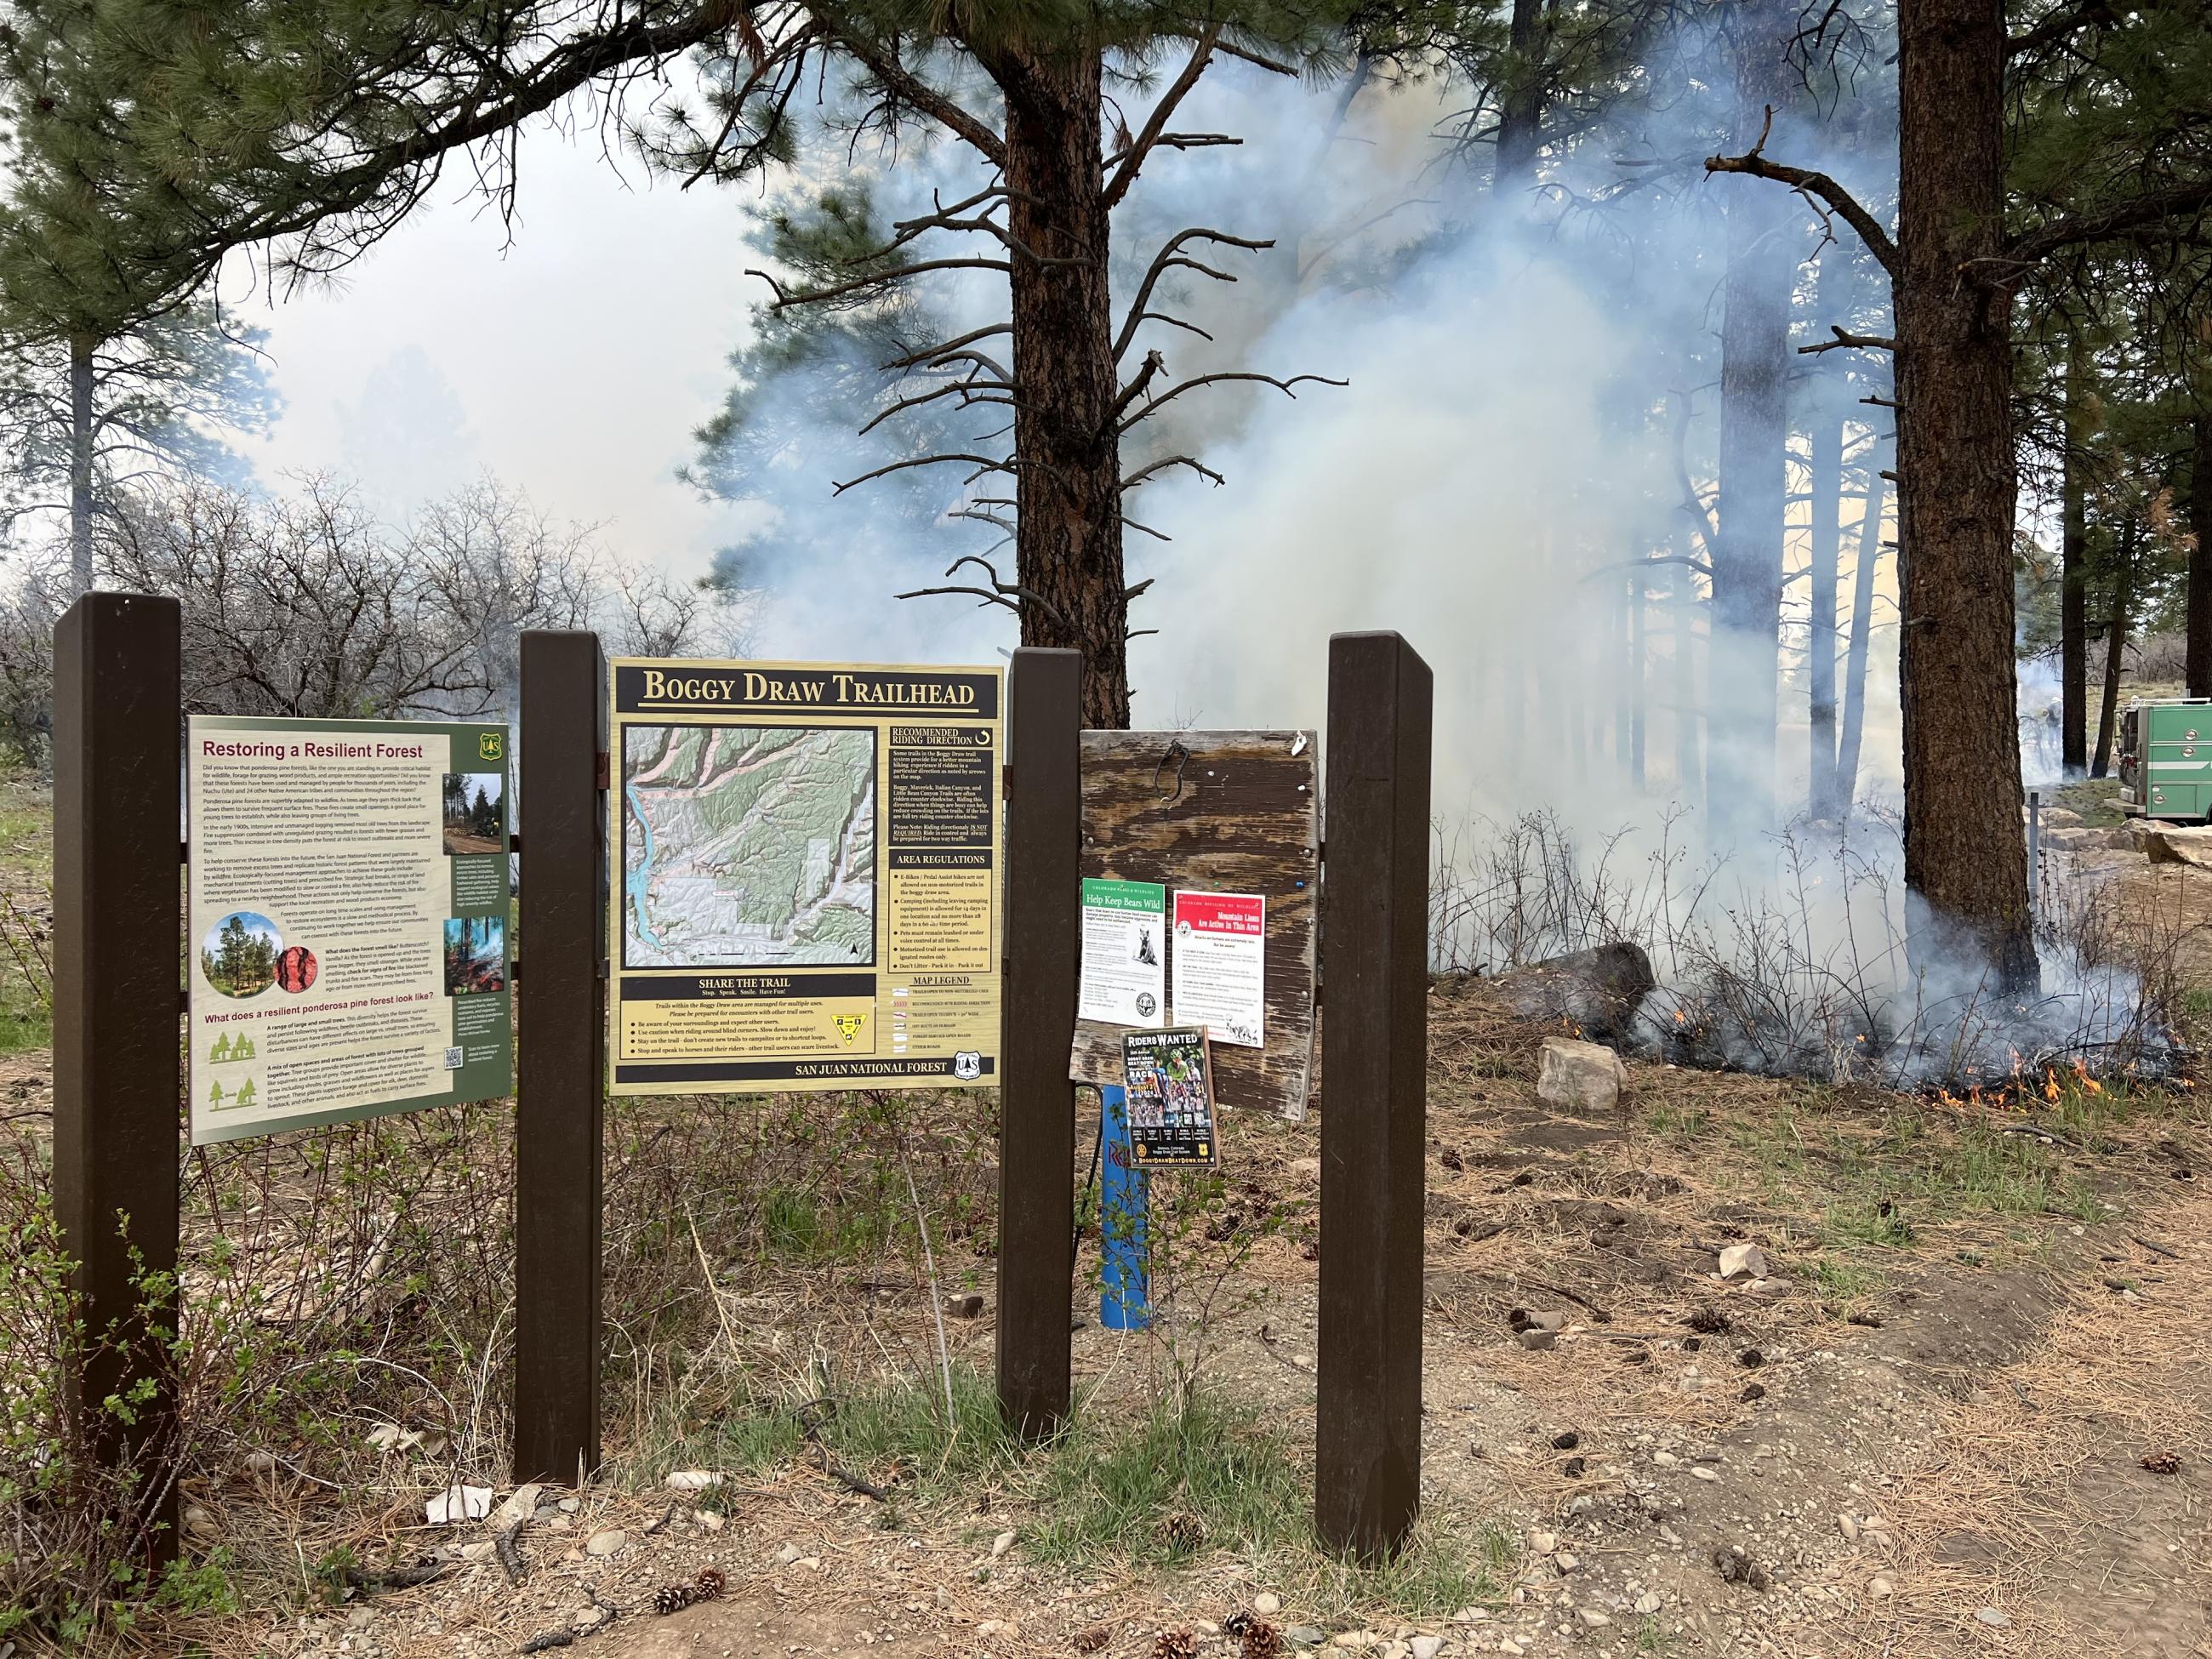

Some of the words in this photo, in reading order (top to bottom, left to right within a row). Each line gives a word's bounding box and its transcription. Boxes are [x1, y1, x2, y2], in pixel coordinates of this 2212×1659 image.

[892, 728, 958, 737] RECOMMENDED
[203, 741, 285, 761] Restoring
[290, 746, 299, 756] a
[305, 743, 371, 757] Resilient
[377, 744, 423, 757] Forest
[1086, 894, 1103, 906] Help
[1104, 896, 1121, 907] Keep
[1124, 898, 1142, 907] Bears
[1143, 899, 1160, 909] Wild
[1217, 912, 1243, 921] Mountain
[1245, 914, 1259, 922] Lions
[1198, 919, 1207, 927] Are
[1209, 920, 1224, 928] Active
[1233, 921, 1245, 930] This
[698, 978, 734, 989] SHARE
[737, 978, 757, 988] THE
[760, 978, 790, 987] TRAIL
[205, 1014, 229, 1023] What
[231, 1012, 254, 1021] does
[265, 1006, 299, 1018] resilient
[303, 1003, 347, 1014] ponderosa
[351, 1000, 368, 1009] pine
[370, 996, 393, 1006] forest
[396, 994, 413, 1002] look
[415, 991, 434, 1001] like?
[795, 1065, 817, 1075] SAN
[818, 1064, 847, 1075] JUAN
[850, 1063, 904, 1074] NATIONAL
[907, 1062, 947, 1072] FOREST
